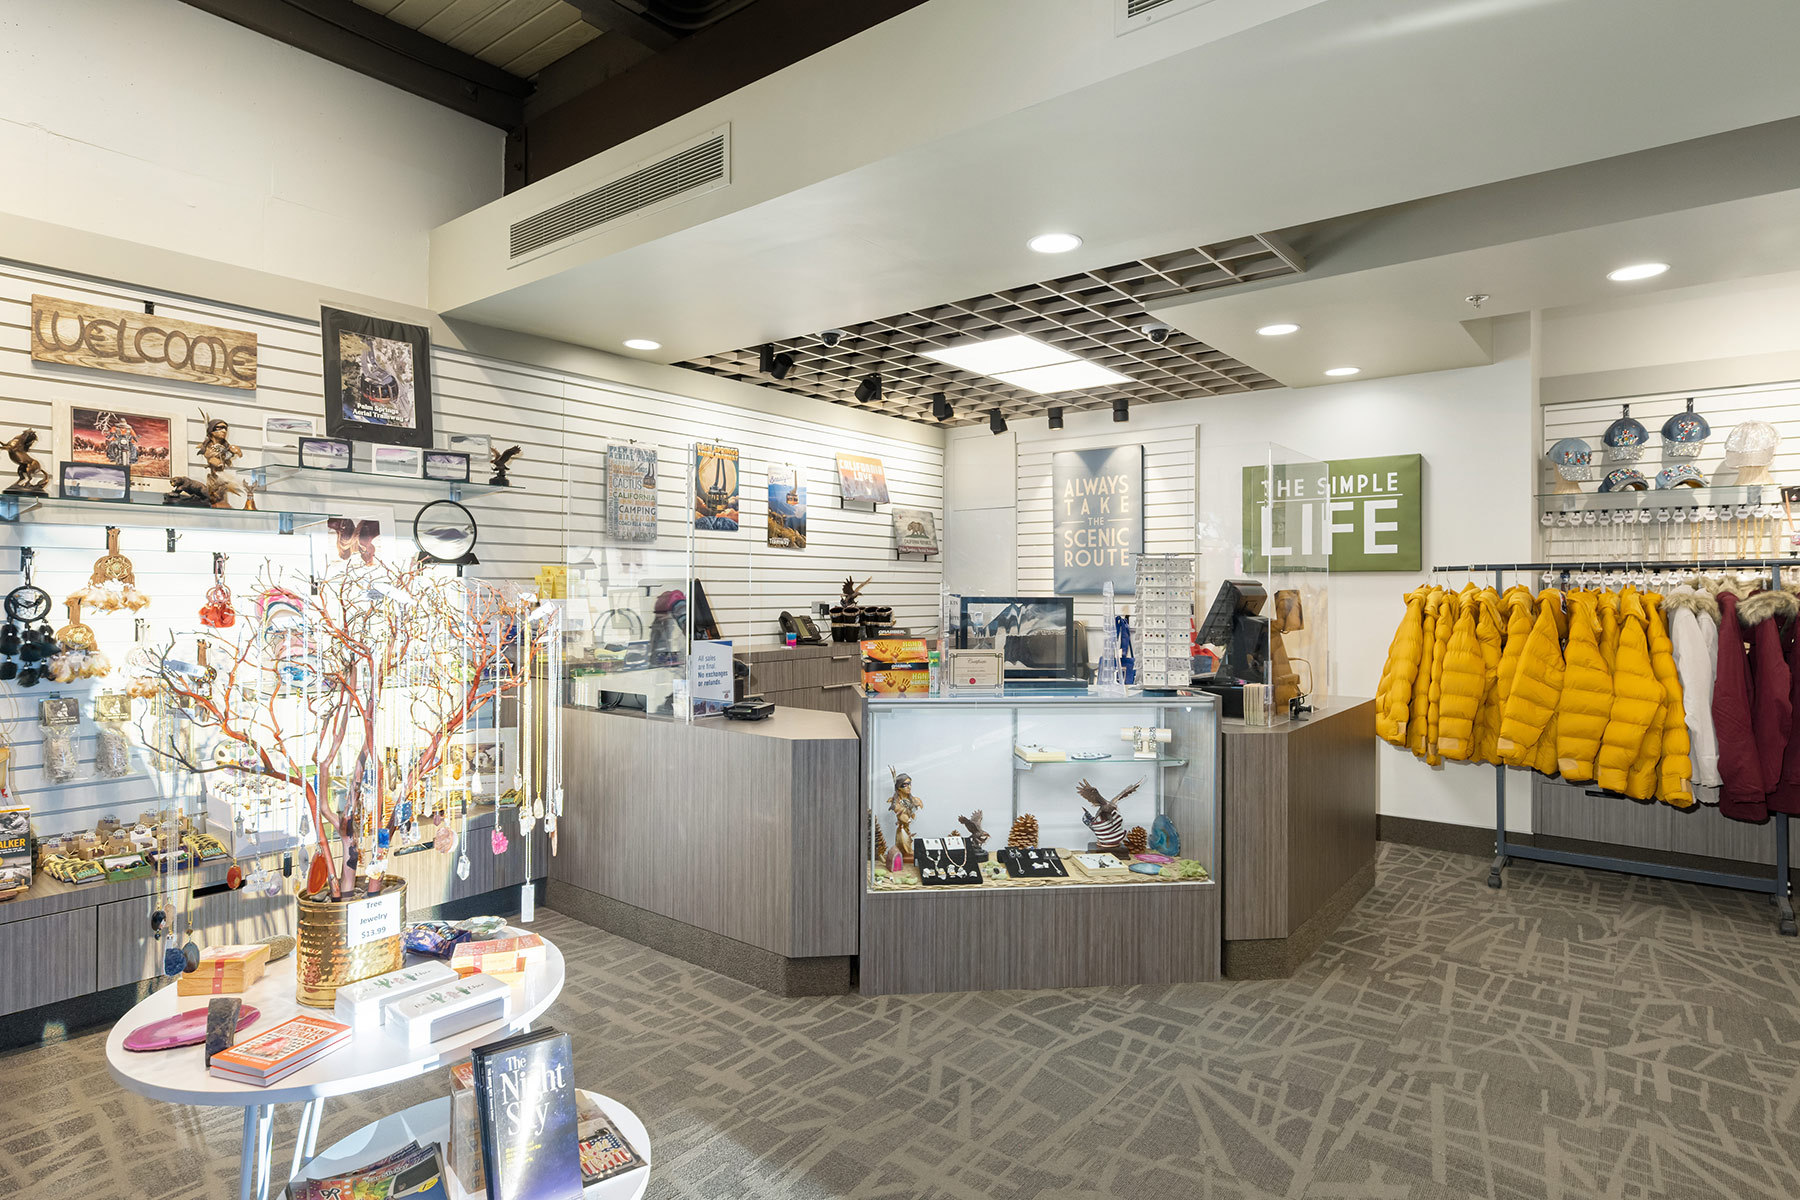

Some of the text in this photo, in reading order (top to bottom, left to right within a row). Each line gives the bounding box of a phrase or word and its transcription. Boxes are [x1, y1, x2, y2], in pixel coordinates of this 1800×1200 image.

[352, 408, 372, 417] Aerial
[357, 402, 399, 415] Palm Springs
[839, 459, 884, 476] CALIFORNIA
[612, 478, 642, 490] CACTUS
[854, 472, 874, 483] LOVE
[1064, 474, 1129, 498] ALWAYS
[1261, 472, 1398, 497] THE SIMPLE
[612, 492, 656, 501] CALIFORNIA
[618, 504, 656, 516] CAMPING
[1064, 496, 1129, 516] TAKE
[1088, 516, 1104, 526] THE
[1261, 499, 1398, 556] LIFE
[1064, 527, 1130, 548] SCENIC
[1064, 548, 1130, 568] ROUTE
[366, 900, 382, 909] Tree
[360, 913, 388, 925] Jewelry
[362, 926, 386, 939] $13.99
[506, 1056, 526, 1072] The
